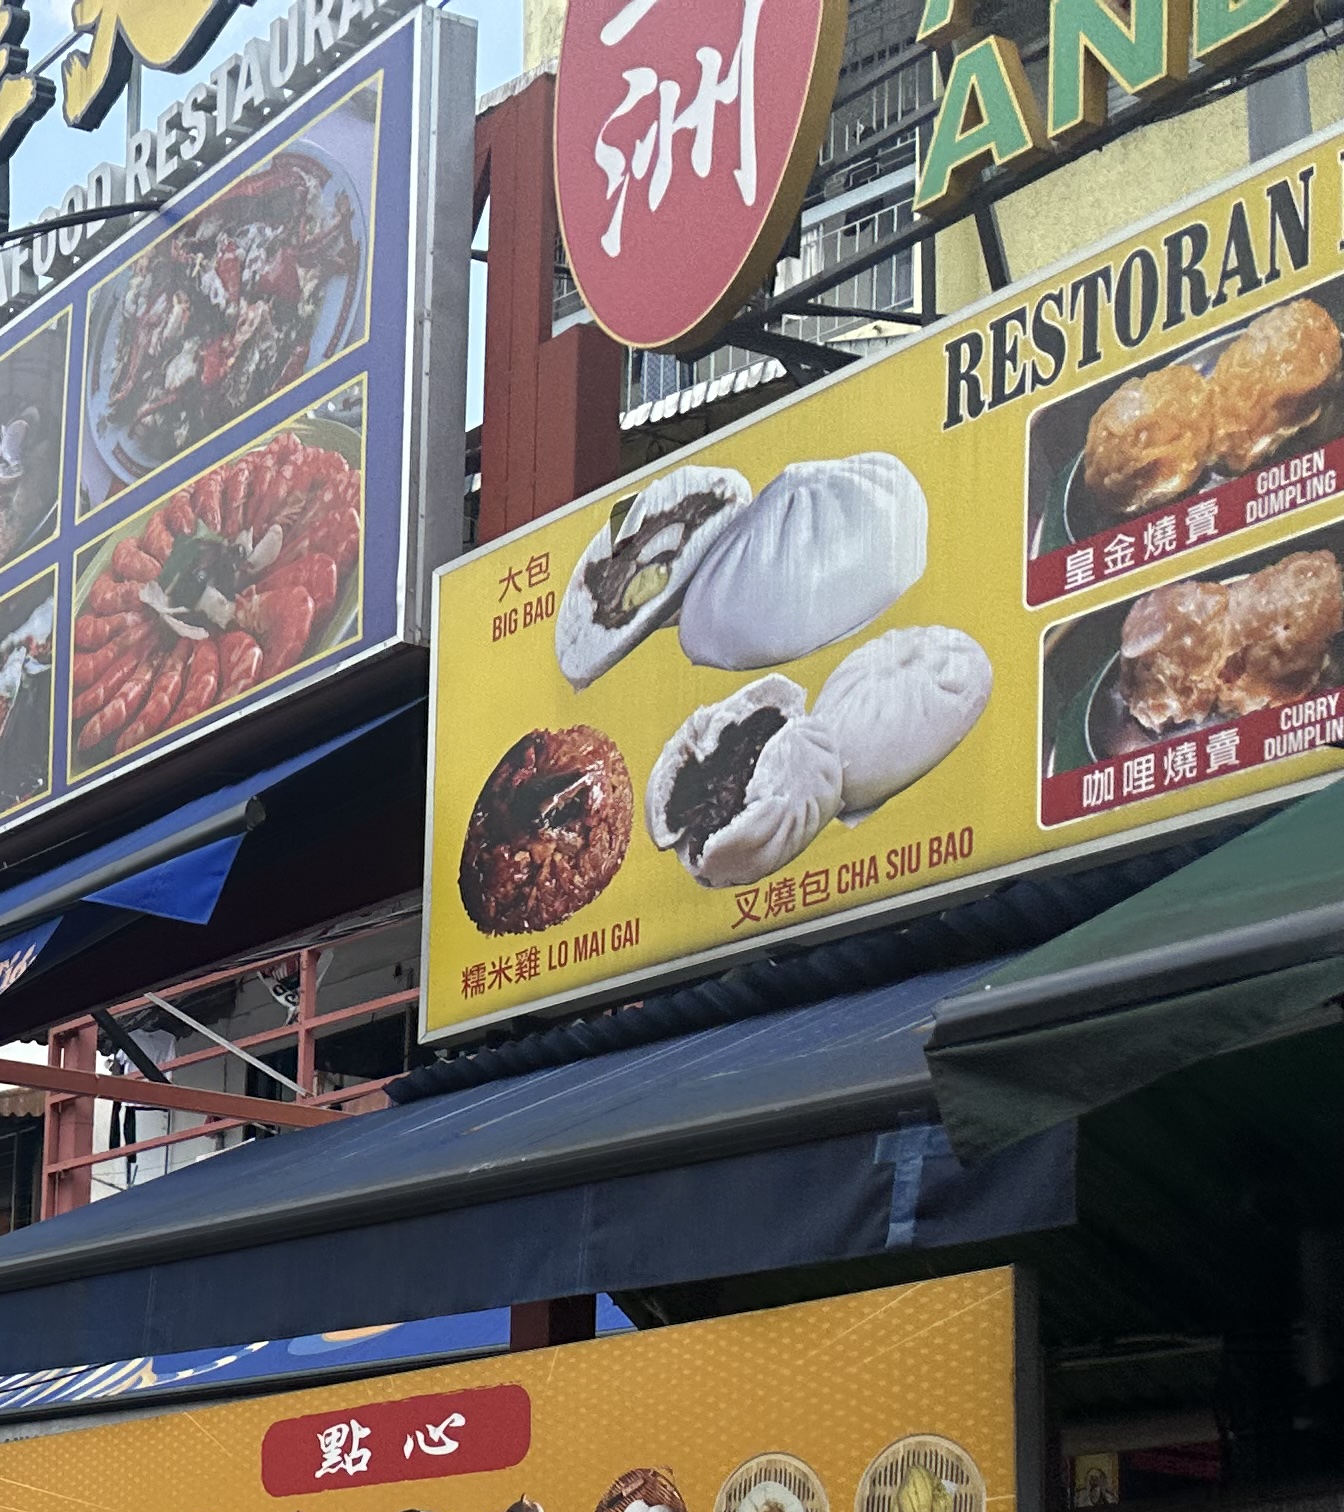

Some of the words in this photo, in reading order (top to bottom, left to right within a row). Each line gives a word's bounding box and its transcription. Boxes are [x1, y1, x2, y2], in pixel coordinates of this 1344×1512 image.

[125, 0, 386, 198] RESTAURA
[943, 165, 1314, 431] RESTORAN
[1246, 470, 1337, 525] DUMPLING
[1256, 448, 1326, 493] GOLDEN
[1064, 496, 1220, 591] 皇金燒賣
[497, 551, 551, 603] 大包
[492, 605, 518, 643] BIG
[522, 590, 556, 632] BAO
[1263, 718, 1344, 763] DUMPLIN
[1279, 692, 1341, 732] CURRY
[1082, 727, 1240, 809] 咖哩燒賣
[730, 869, 830, 931] 叉燒包
[836, 858, 880, 896] CHA
[885, 842, 922, 882] SIU
[928, 825, 975, 868] BAO
[460, 945, 541, 1000] 糯米雞
[547, 945, 570, 972] LO
[573, 931, 606, 965] MAI
[610, 917, 641, 953] GAI
[313, 1412, 467, 1478] 點心
